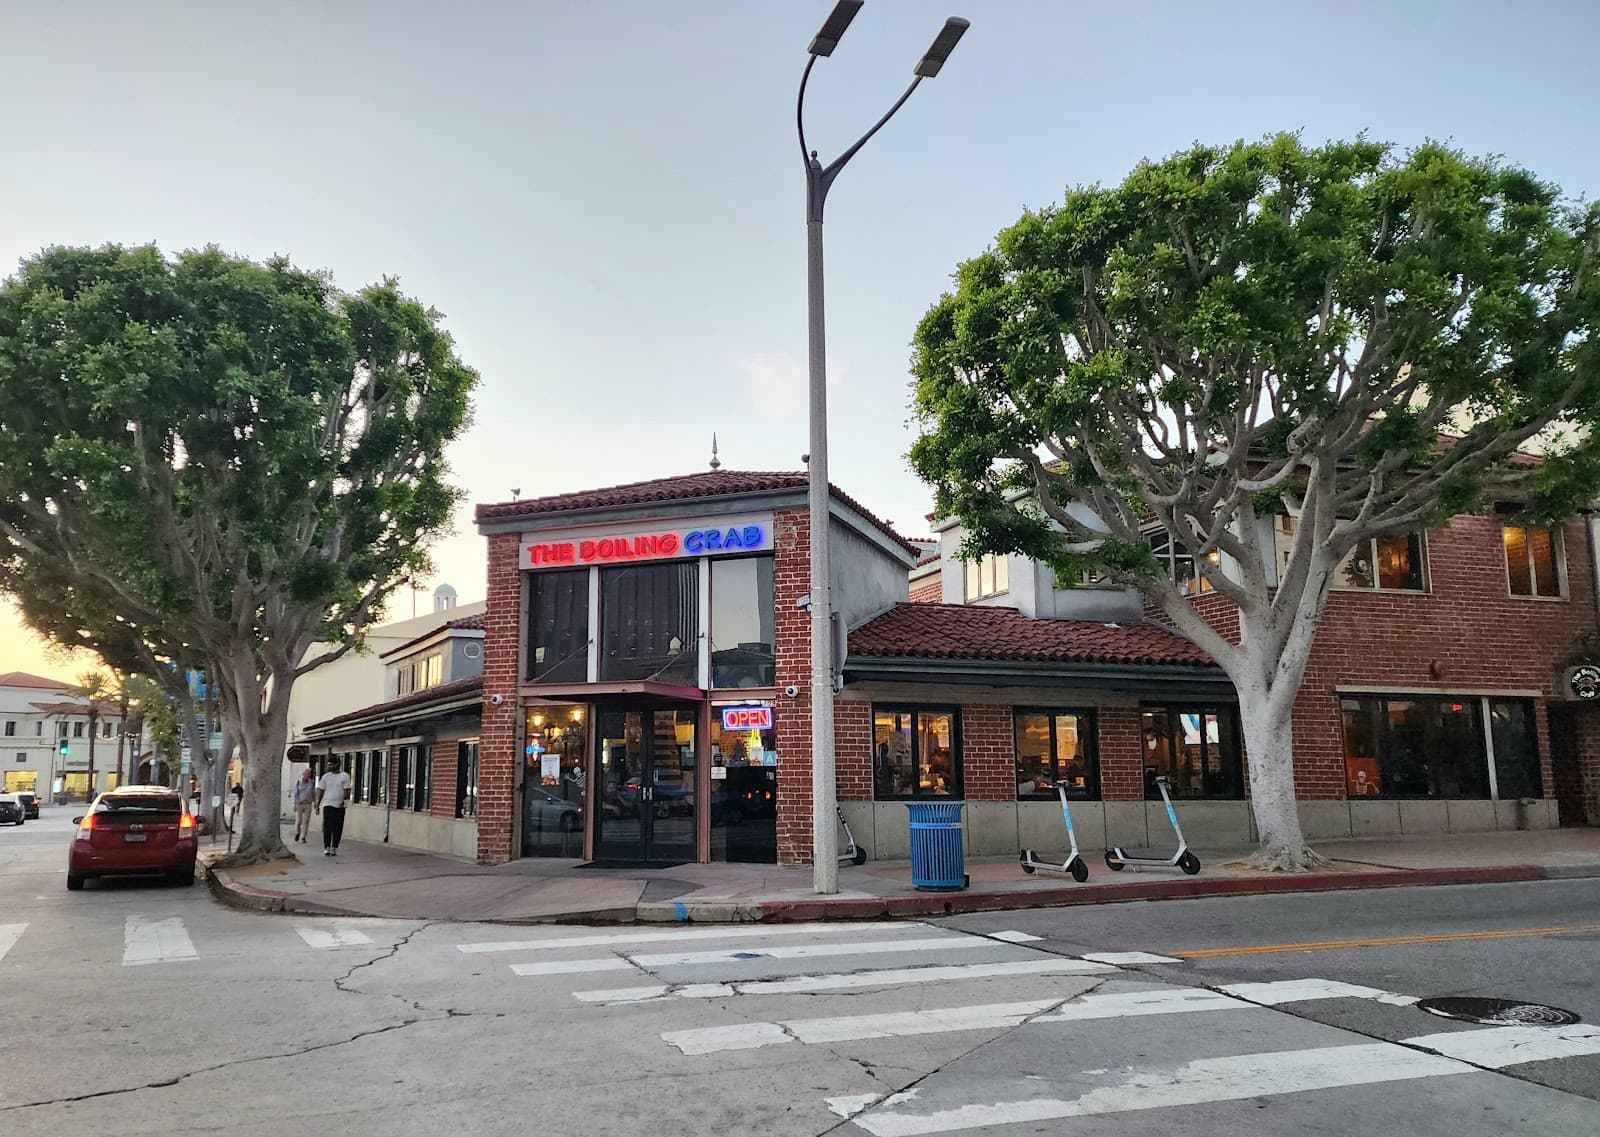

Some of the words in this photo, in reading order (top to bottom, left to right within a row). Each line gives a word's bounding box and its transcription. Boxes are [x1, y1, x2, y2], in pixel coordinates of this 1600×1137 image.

[527, 543, 575, 565] THE
[580, 534, 678, 562] BOILING
[683, 526, 762, 552] CRAB
[726, 710, 769, 727] OPEN
[766, 754, 773, 764] A
